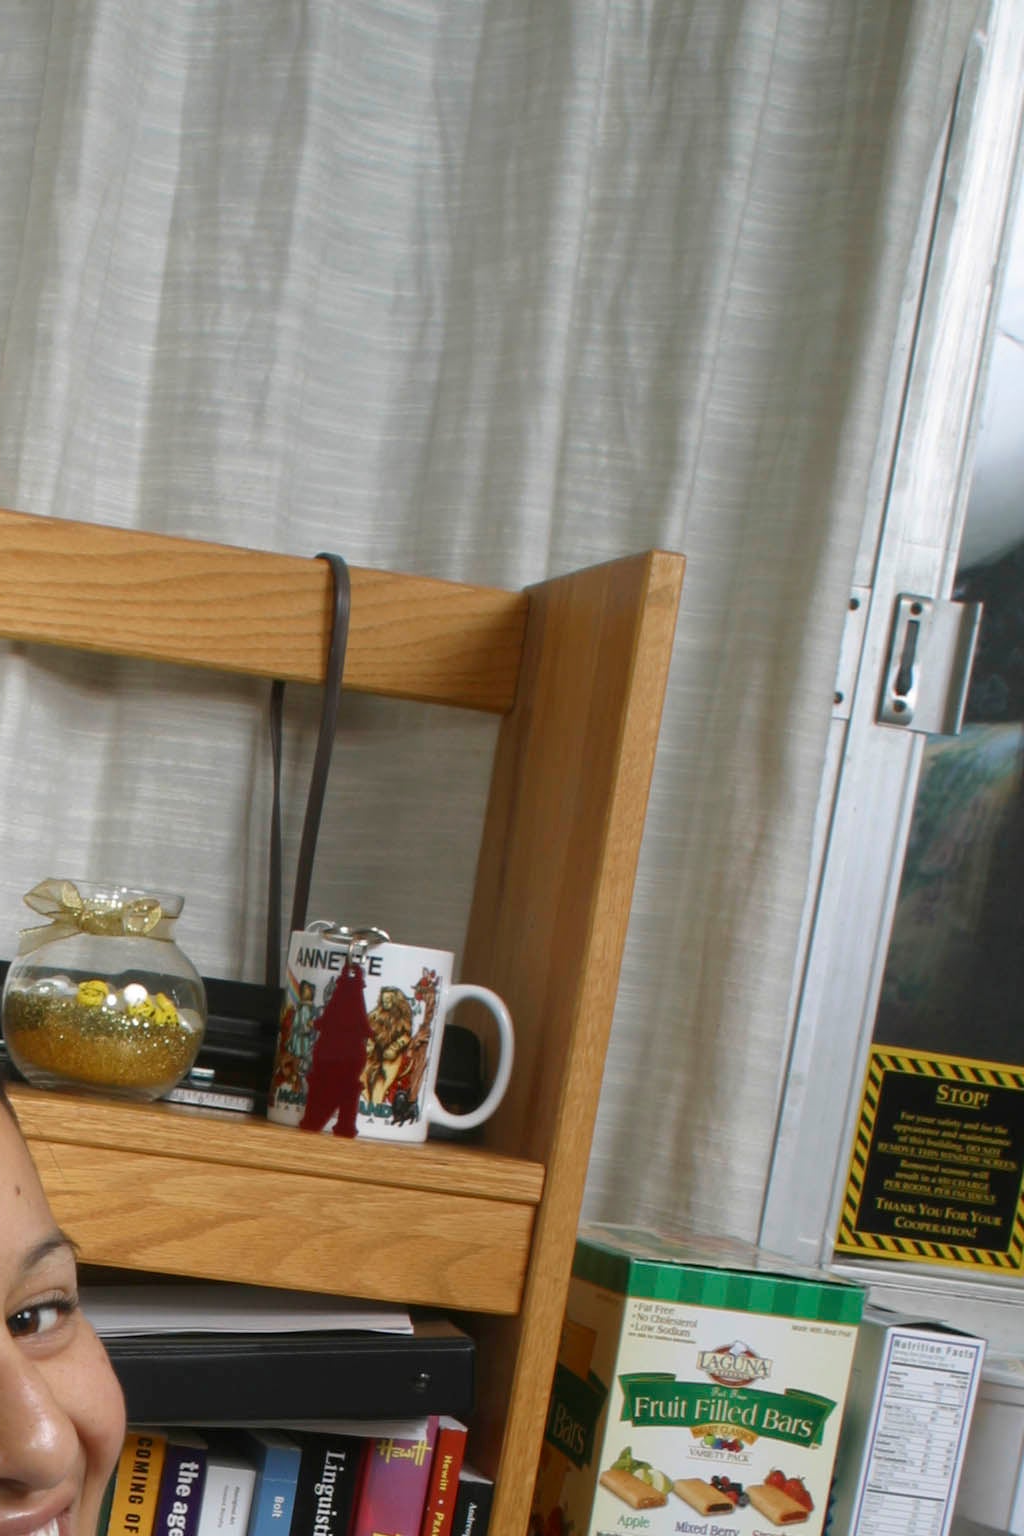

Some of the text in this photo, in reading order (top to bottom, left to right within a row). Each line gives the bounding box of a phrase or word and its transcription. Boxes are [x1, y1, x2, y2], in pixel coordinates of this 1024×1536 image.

[936, 1083, 989, 1108] STOP!
[919, 1202, 943, 1217] YOU
[945, 1207, 969, 1221] FOR
[637, 1303, 676, 1315] Fat Free
[634, 1322, 655, 1333] Low
[656, 1324, 690, 1338] Sodium
[636, 1312, 698, 1329] No Cholesterol
[894, 1339, 942, 1354] Nutrition
[945, 1346, 974, 1359] Facts
[699, 1352, 769, 1377] LAGUNA
[634, 1396, 814, 1438] Fruit Filled Bars
[128, 1437, 153, 1505] COMING
[175, 1461, 200, 1498] the
[440, 1455, 453, 1490] Hewitt
[272, 1496, 285, 1518] Bolt
[124, 1513, 141, 1534] OF
[617, 1515, 651, 1530] Apple
[675, 1521, 708, 1536] Mixed
